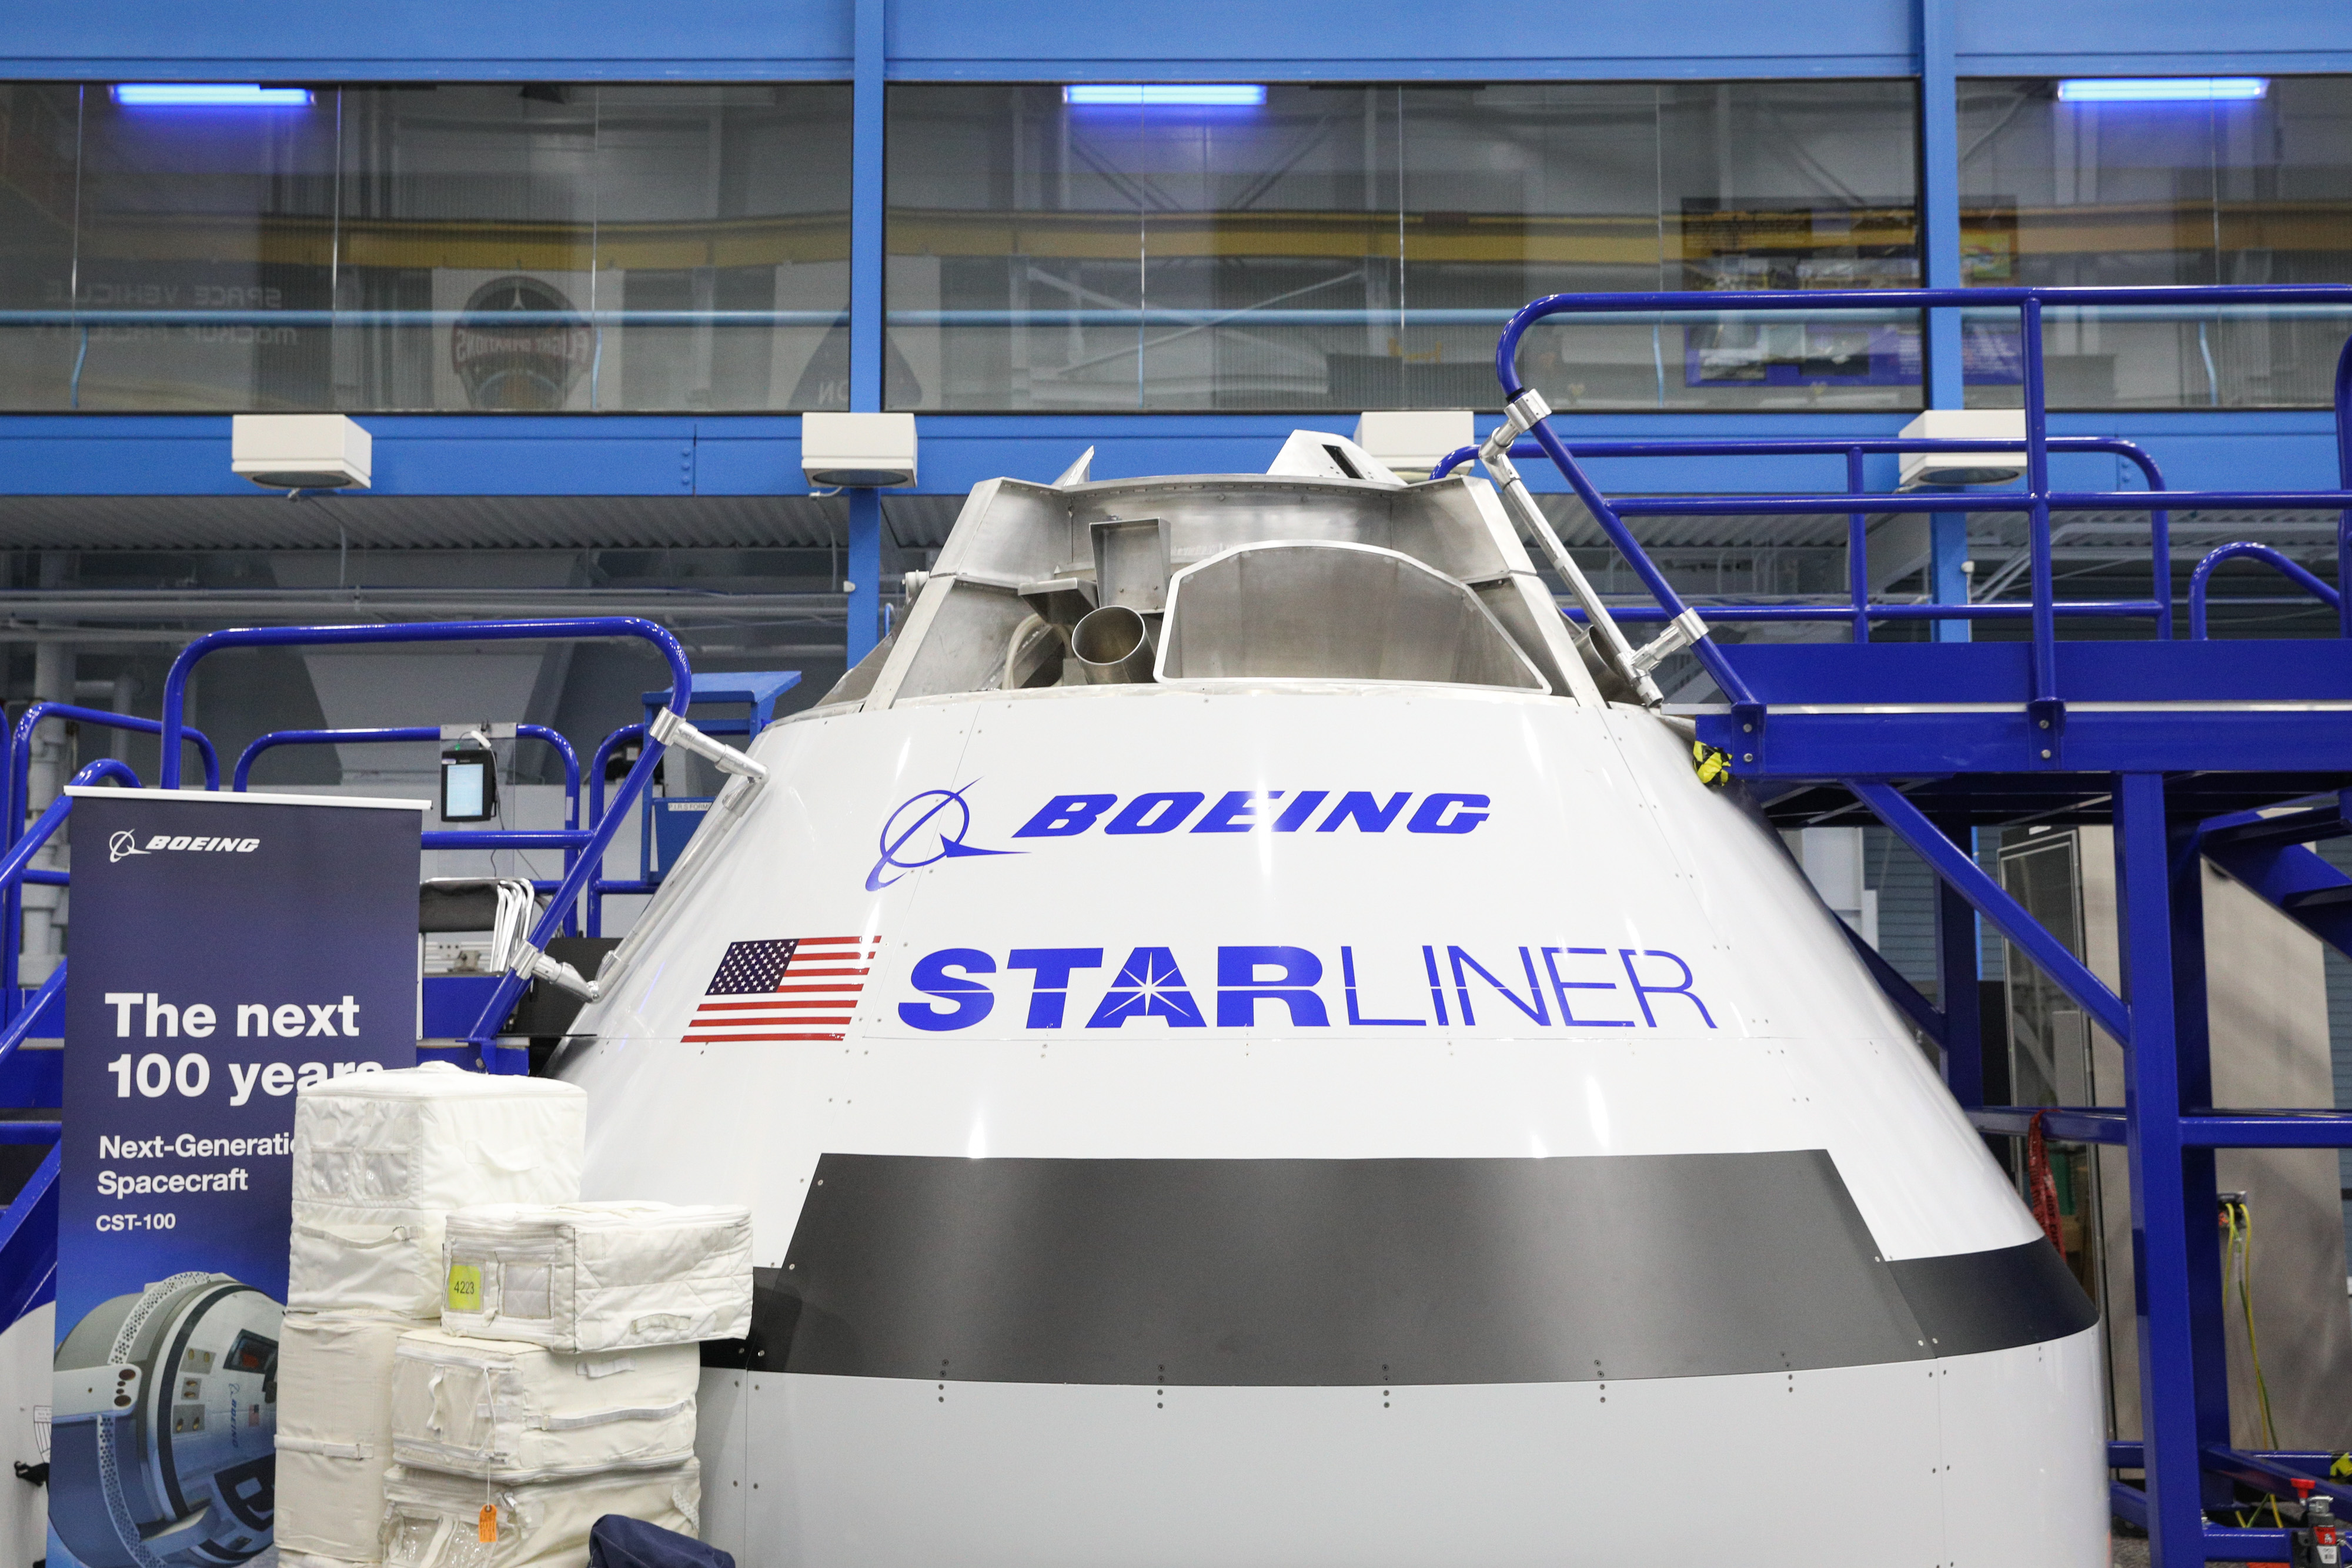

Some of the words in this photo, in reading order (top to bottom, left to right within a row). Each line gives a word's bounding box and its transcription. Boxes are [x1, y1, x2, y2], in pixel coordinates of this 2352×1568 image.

[1011, 791, 1491, 838] BOEING
[146, 835, 260, 852] BOEING
[898, 945, 1718, 1031] STARLINER
[105, 992, 216, 1038] The
[236, 995, 360, 1038] next
[108, 1052, 210, 1098] 100
[228, 1061, 384, 1106] yea
[97, 1168, 248, 1199] Spacecraft
[96, 1213, 176, 1232] CST-100
[454, 1281, 474, 1295] 4223
[230, 1398, 239, 1447] BOEING
